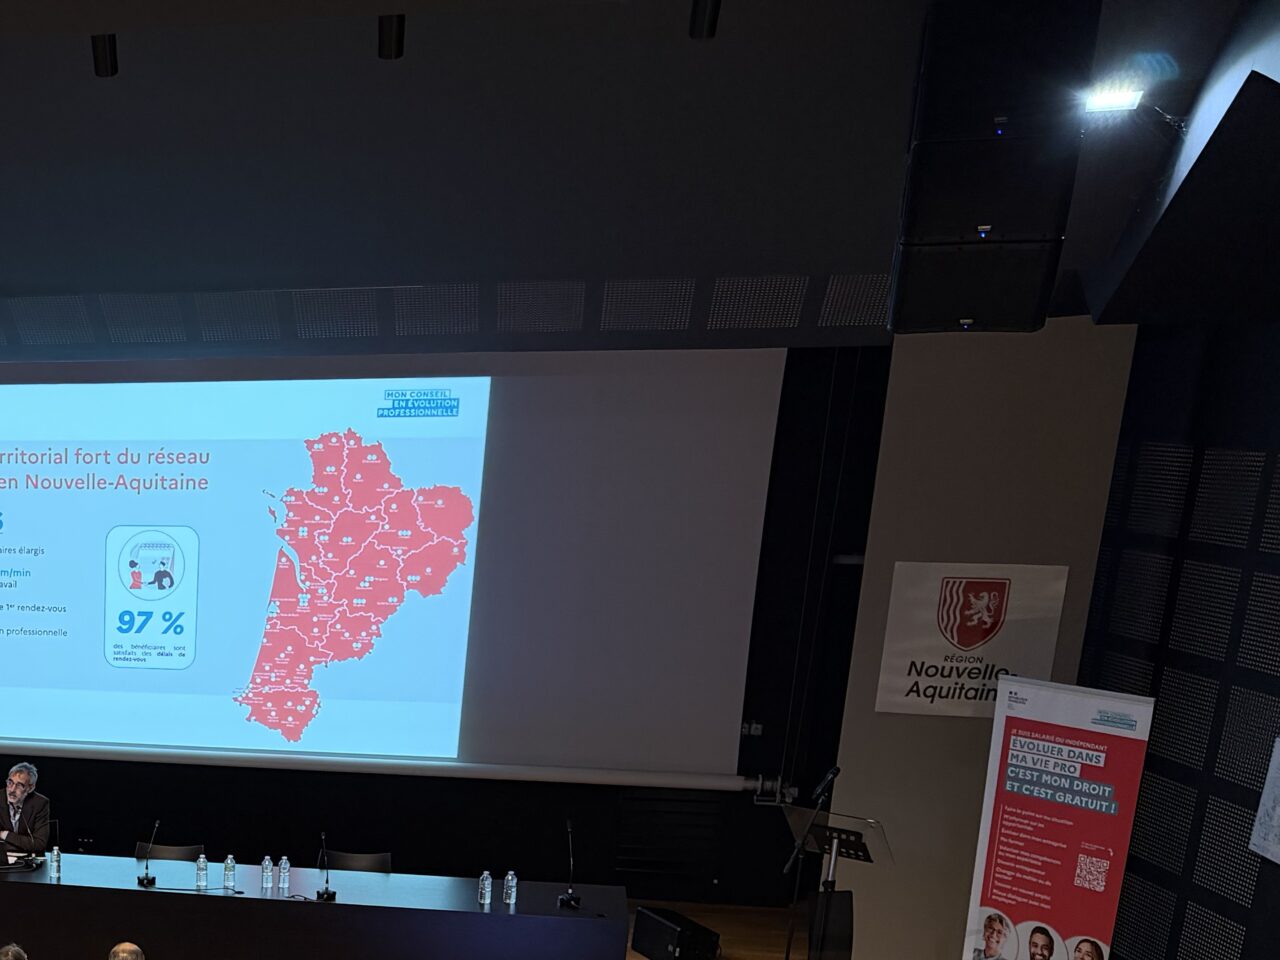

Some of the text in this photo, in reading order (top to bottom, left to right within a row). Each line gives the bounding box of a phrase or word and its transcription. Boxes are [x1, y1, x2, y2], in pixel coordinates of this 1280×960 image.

[378, 408, 458, 416] PROFESSIONNELLE
[408, 399, 458, 408] ÉVOLUTION
[74, 447, 111, 464] fort
[117, 448, 141, 464] du
[148, 447, 210, 464] réseau
[25, 473, 209, 495] Nouvelle-Aquitaine
[18, 546, 45, 556] élargis
[18, 604, 67, 612] rendez-vous
[6, 627, 68, 637] professionnelle
[116, 610, 185, 635] 97 %
[944, 653, 984, 664] RÉGION
[904, 680, 998, 704] Aquitain
[1012, 738, 1102, 764] ÉVOLUER DANS
[1010, 752, 1078, 774] MA VIE PRO
[1008, 766, 1112, 797] C'EST MON DROIT
[1006, 780, 1020, 792] ET
[1022, 784, 1054, 799] C'EST
[1056, 792, 1109, 812] GRATUIT
